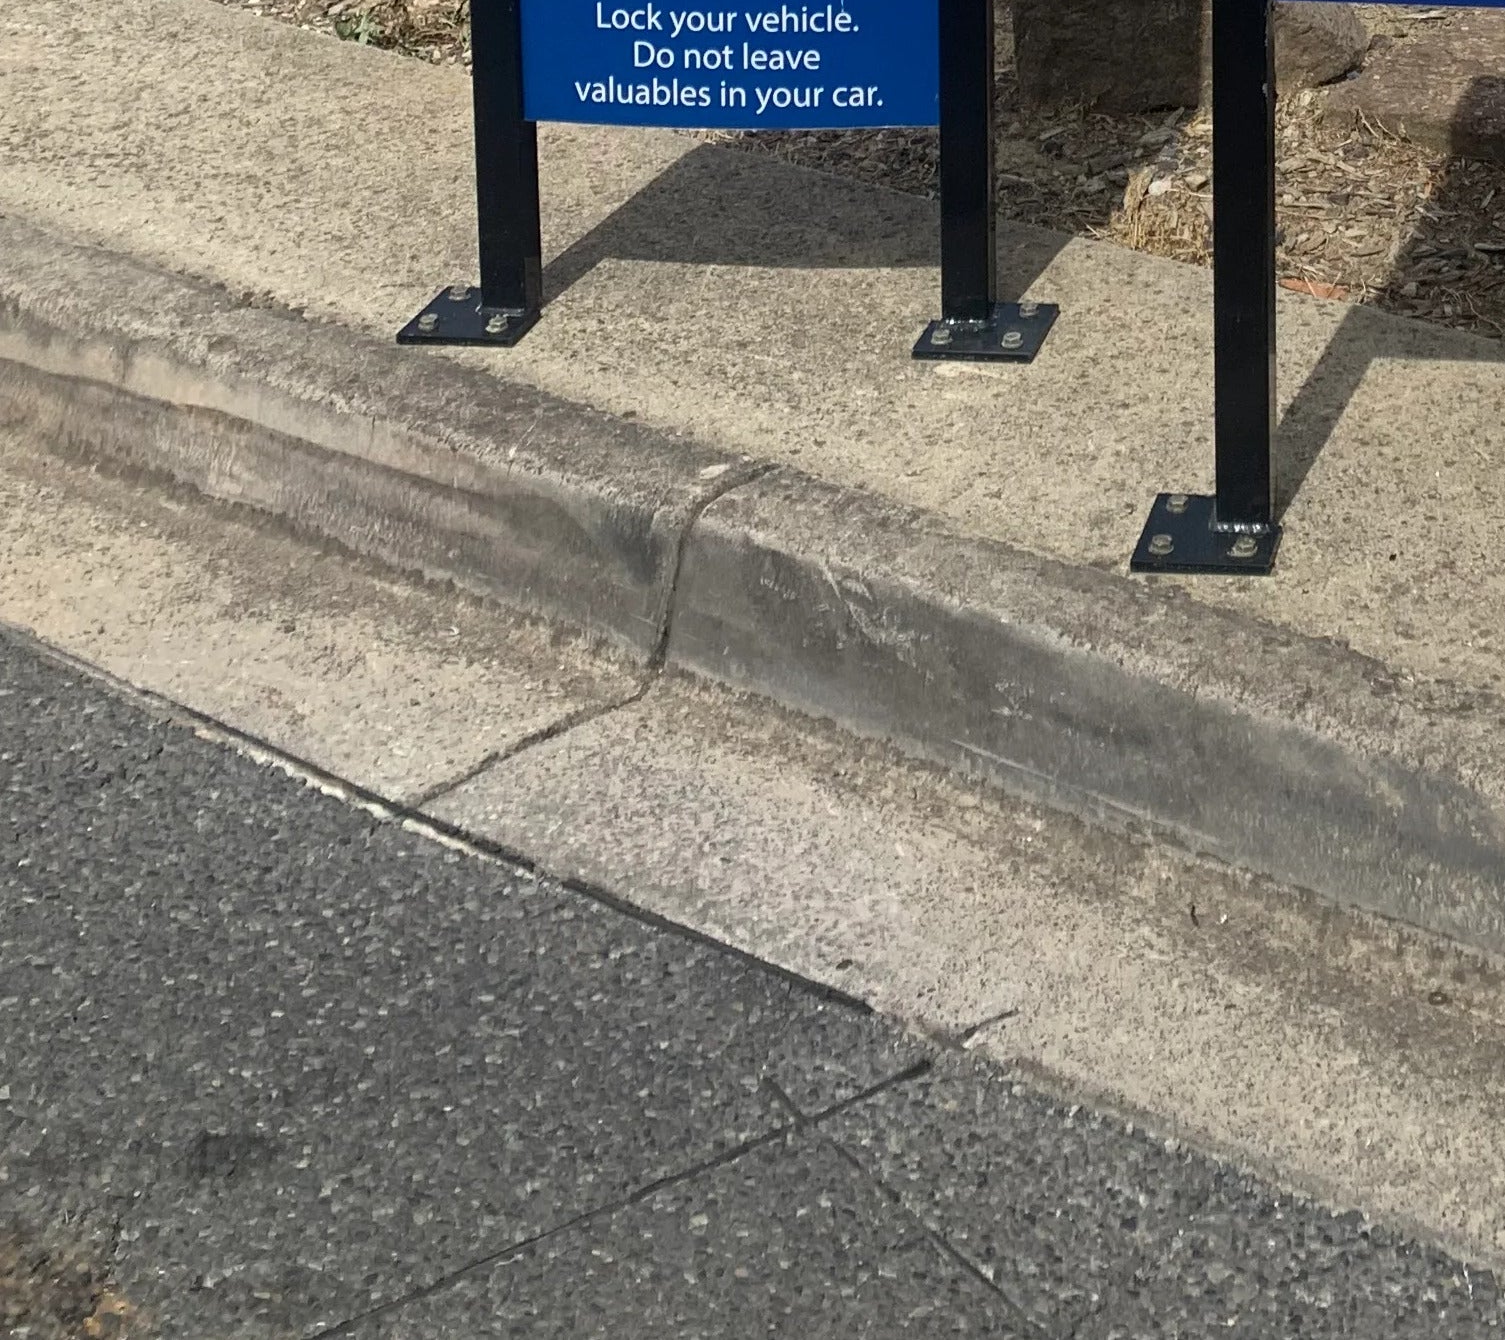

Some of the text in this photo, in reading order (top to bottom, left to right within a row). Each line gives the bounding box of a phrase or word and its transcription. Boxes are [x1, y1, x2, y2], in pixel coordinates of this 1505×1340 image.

[597, 2, 858, 37] Lock your vehicle.
[634, 41, 820, 70] Do not leave
[575, 76, 882, 114] valuables in your car.
